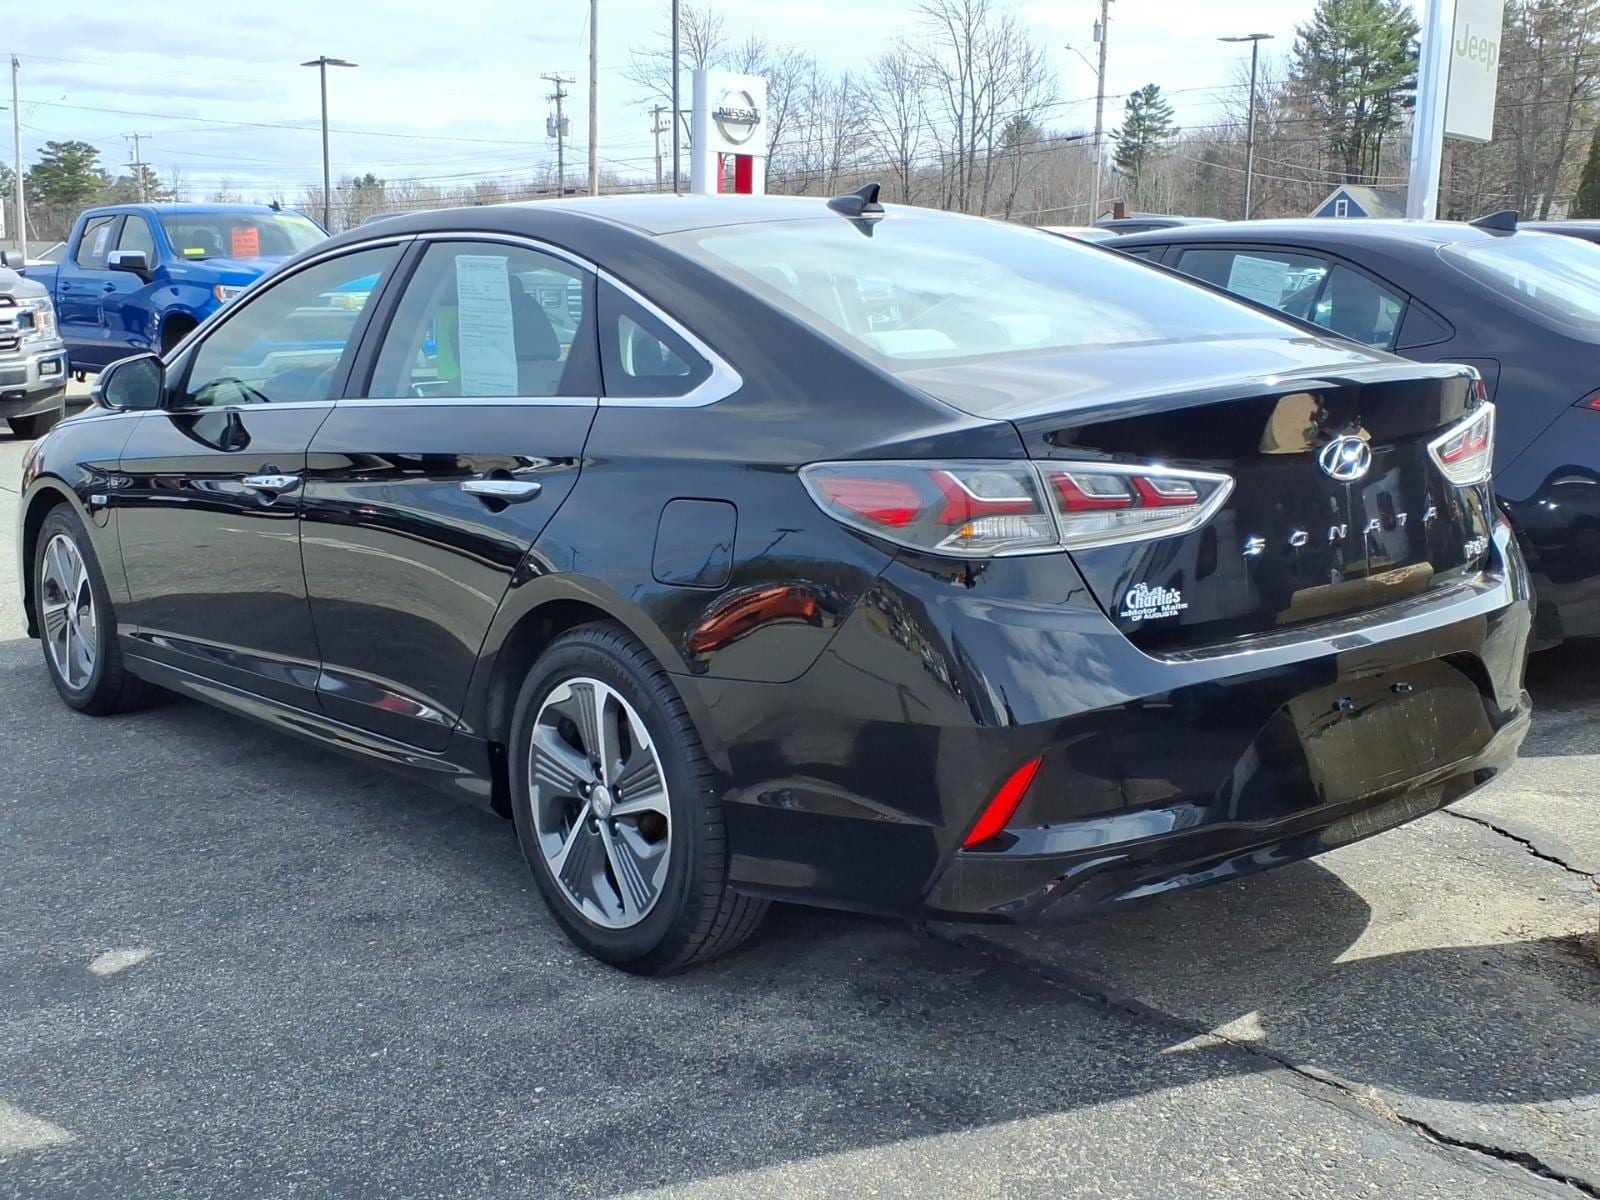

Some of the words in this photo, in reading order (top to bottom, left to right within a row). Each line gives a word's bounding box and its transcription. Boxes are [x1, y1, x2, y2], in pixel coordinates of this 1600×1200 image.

[1456, 24, 1497, 72] Jeep
[1243, 506, 1437, 556] SONATA
[1126, 588, 1181, 609] Charlie's
[1128, 607, 1157, 617] Motor
[1161, 603, 1181, 612] Mall
[1144, 610, 1178, 620] AUGUSTA
